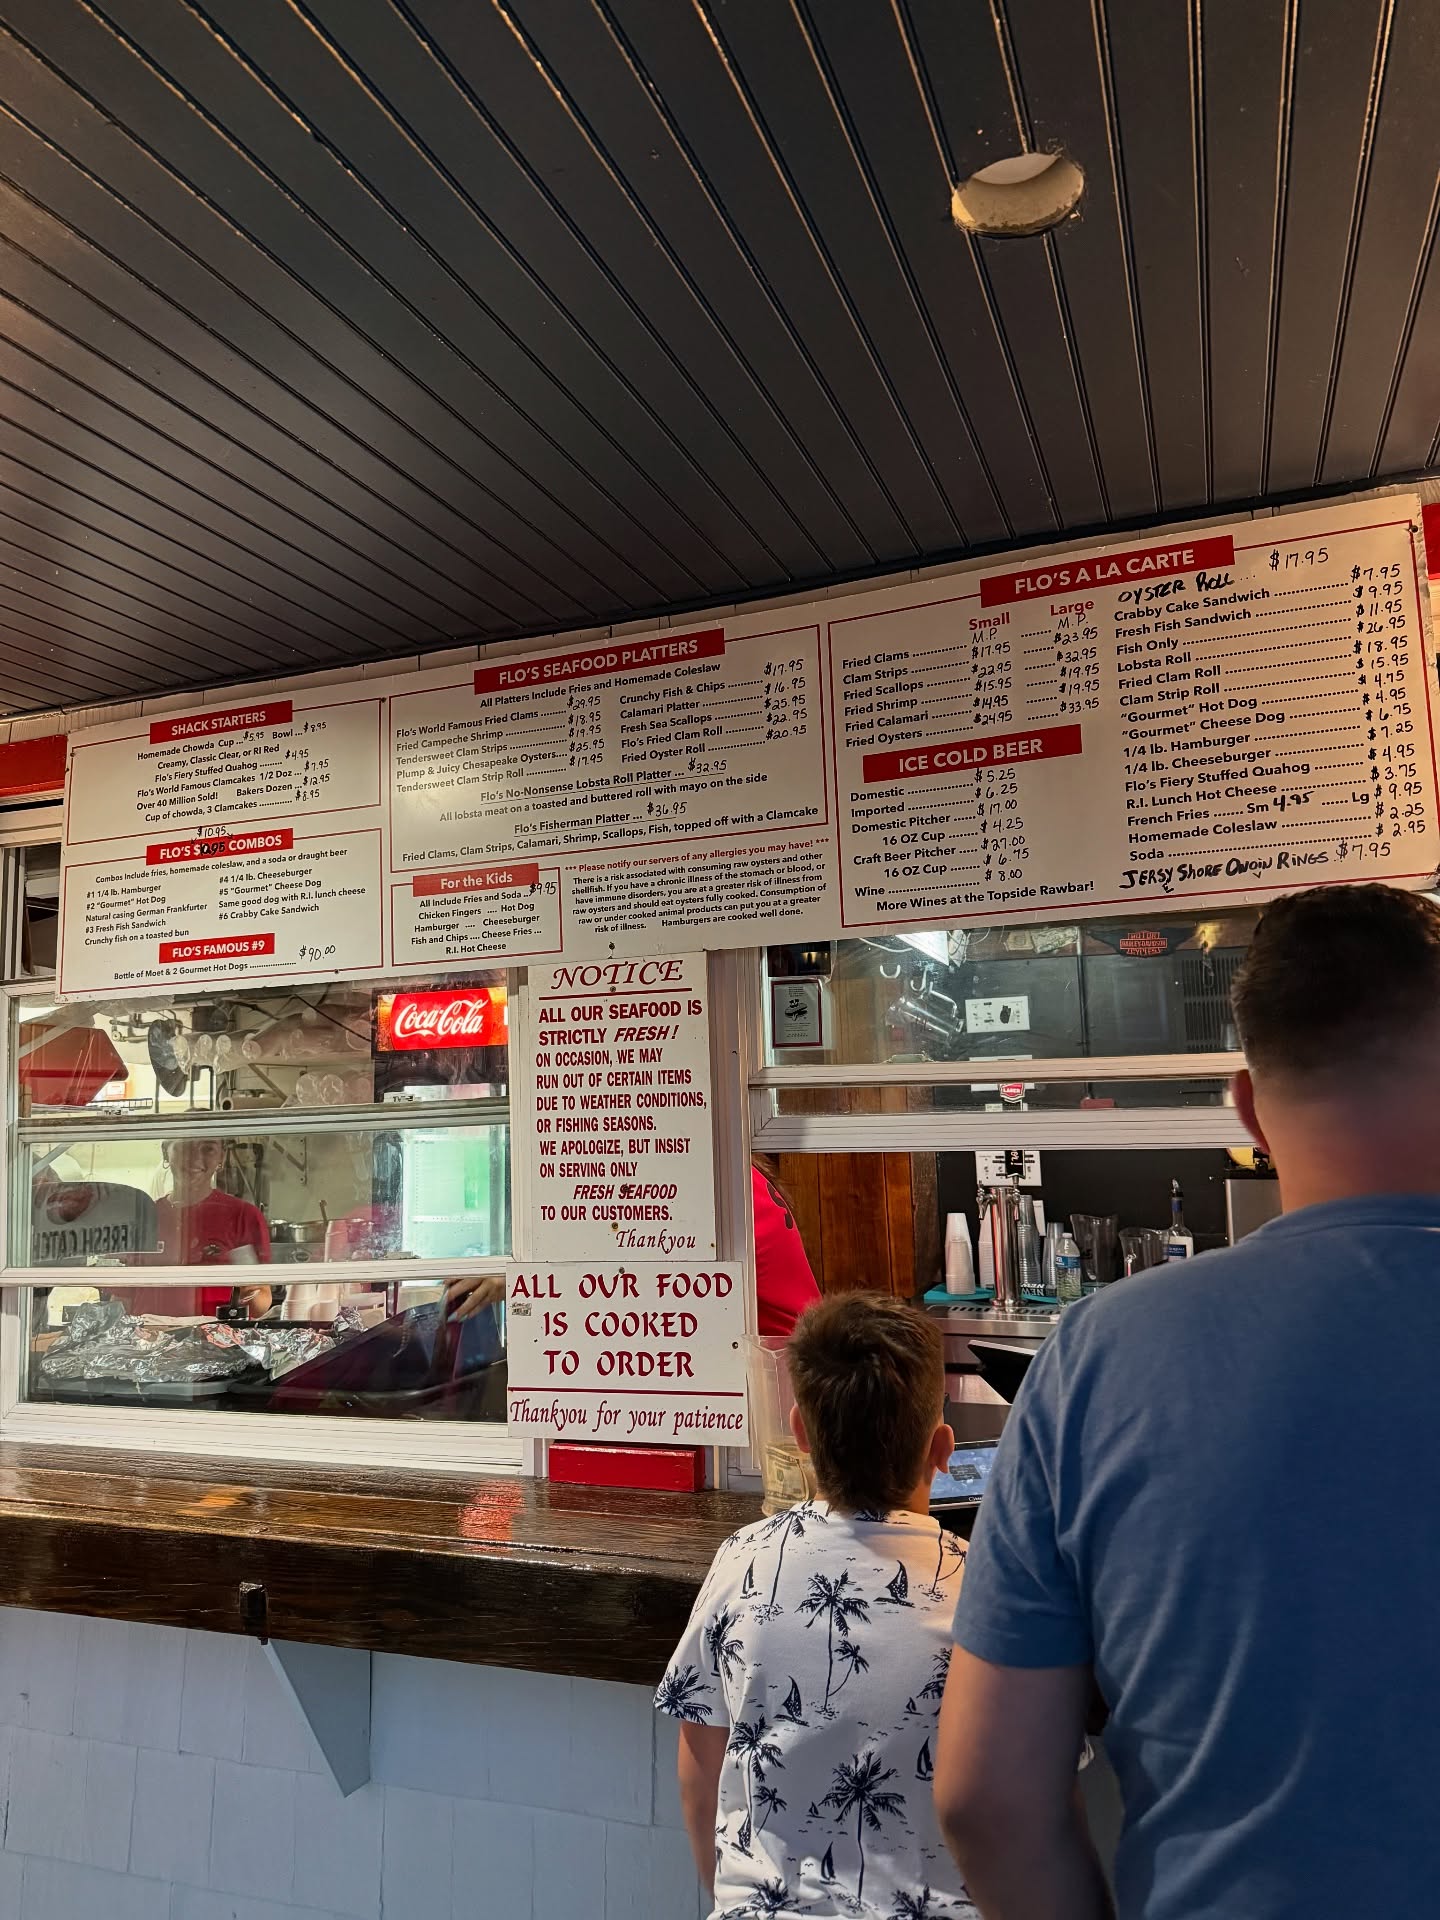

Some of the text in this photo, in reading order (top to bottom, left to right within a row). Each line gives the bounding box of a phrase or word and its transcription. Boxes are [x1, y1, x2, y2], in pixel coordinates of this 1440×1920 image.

[1015, 550, 1195, 595] FLO'S A LA CARTE
[968, 600, 1095, 631] Small Large
[1114, 604, 1163, 622] Crabby
[1166, 599, 1199, 613] Cake
[1203, 588, 1269, 608] Sandwich
[499, 640, 698, 685] FLO'S SEAFOOD PLATTERS
[1118, 656, 1162, 672] Lobsta
[1165, 652, 1191, 664] Roll
[843, 672, 872, 685] Clam
[875, 666, 908, 681] Strips
[620, 691, 660, 705] Crunchy
[662, 687, 683, 697] Fish
[686, 685, 693, 694] &
[696, 682, 725, 693] Chips
[171, 711, 266, 736] SHACK STARTERS
[397, 728, 416, 738] Flo's
[419, 723, 445, 735] World
[448, 718, 482, 731] Famous
[484, 715, 507, 725] Fried
[510, 711, 538, 721] Clams
[137, 748, 181, 760] Homemade
[183, 741, 215, 753] Chowda
[218, 738, 234, 749] Cup
[272, 729, 293, 740] Bowl
[899, 739, 1043, 773] ICE COLD BEER
[155, 772, 173, 782] Flo's
[174, 769, 193, 781] Fiery
[195, 764, 222, 776] Stuffed
[225, 761, 257, 775] Quahog
[1128, 812, 1172, 827] French
[1176, 809, 1209, 823] Fries
[1247, 803, 1269, 813] Sm
[1352, 791, 1369, 805] Lg
[514, 822, 536, 834] Flo's
[539, 816, 592, 830] Fisherman
[595, 811, 630, 823] Platter
[160, 847, 190, 859] FLO'S
[229, 835, 282, 850] COMBOS
[578, 863, 606, 872] Please
[607, 861, 631, 870] notify
[649, 856, 679, 865] servers
[681, 853, 690, 861] of
[692, 851, 707, 861] any
[709, 847, 747, 858] allergies
[767, 845, 787, 853] may
[788, 841, 813, 850] have!
[854, 854, 882, 865] Craft
[884, 850, 911, 861] Beer
[914, 846, 956, 859] Pitcher
[440, 871, 513, 889] For the Kids
[876, 881, 1094, 911] More Wines at the Topside Rawbar!
[172, 940, 265, 958] FLO'S FAMOUS #9
[114, 971, 134, 980] Bottle
[136, 970, 144, 978] of
[146, 969, 164, 977] Moet
[166, 968, 171, 976] &
[173, 967, 178, 975] 2
[179, 965, 211, 975] Gourmet
[213, 964, 227, 973] Hot
[229, 962, 248, 973] Dogs
[551, 960, 683, 990] NOTICE
[395, 1000, 488, 1037] Coca-Cola
[539, 1000, 702, 1023] ALL OUR SEAFOOD IS
[539, 1028, 606, 1046] STRICTLY
[536, 1048, 663, 1067] ON OCCASION, WE MAY
[536, 1069, 692, 1090] RUN OUT OF CERTAIN ITEMS
[536, 1092, 707, 1111] DUE TO WEATHER CONDITIONS,
[537, 1116, 656, 1132] OR FISHING SEASONS.
[540, 1138, 690, 1156] WE APOLOGIZE, BUT INSIST
[540, 1162, 638, 1178] ON SERVING ONLY
[574, 1184, 678, 1200] FRESH SEAFOOD
[541, 1205, 673, 1220] TO OUR CUSTOMERS.
[616, 1229, 696, 1254] Thankyou
[511, 1273, 732, 1298] ALL OUR FOOD
[543, 1312, 698, 1337] IS COOKED
[543, 1351, 695, 1377] TO ORDER
[510, 1399, 743, 1435] Thankyou for your patience
